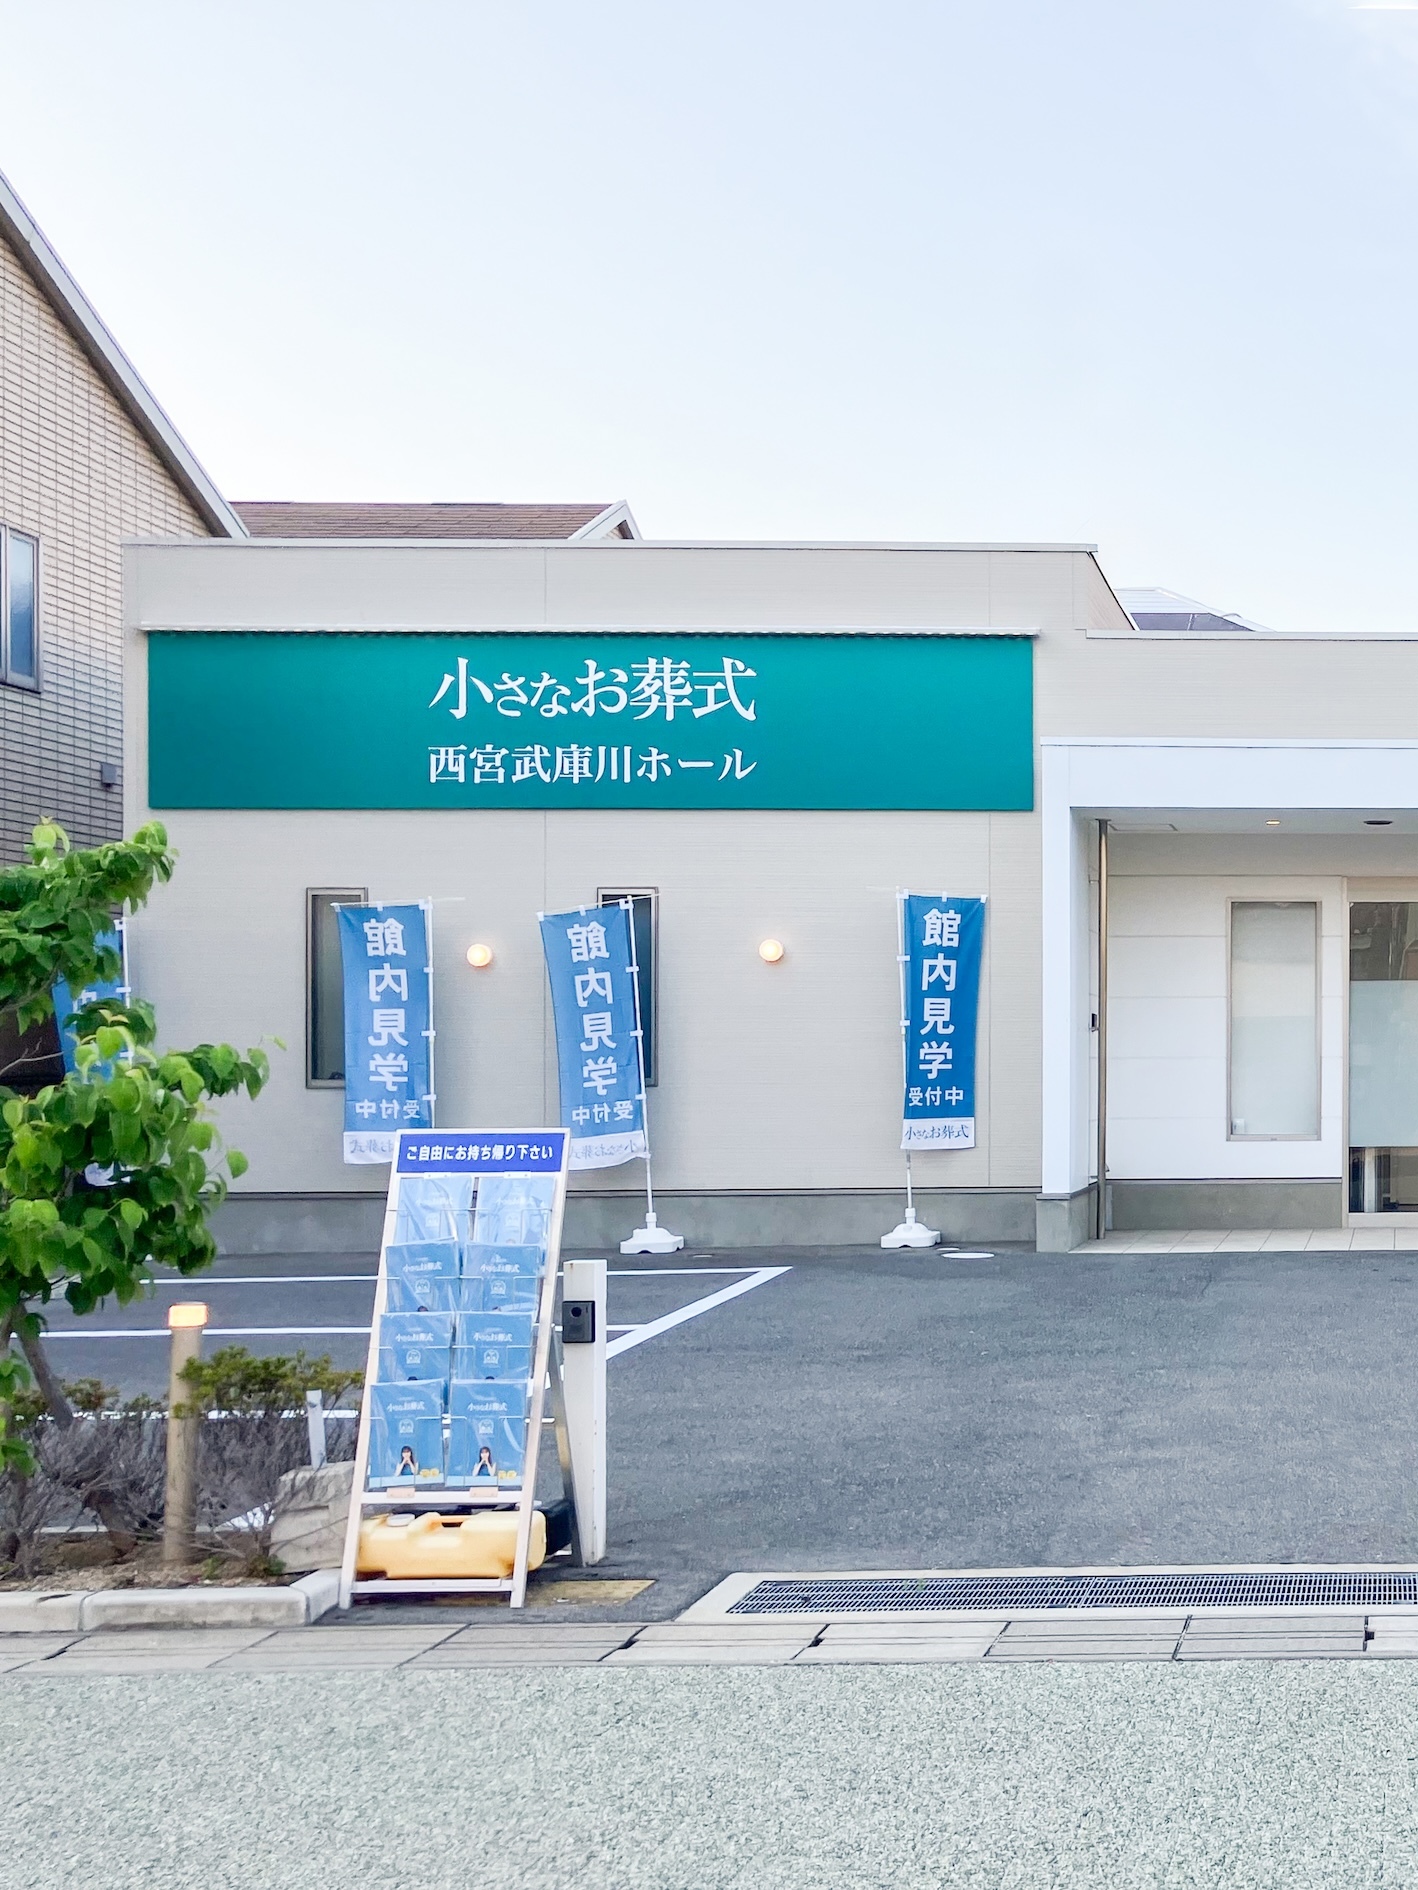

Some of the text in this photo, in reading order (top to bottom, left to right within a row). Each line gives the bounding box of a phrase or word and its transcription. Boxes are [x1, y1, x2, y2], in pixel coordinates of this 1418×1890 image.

[428, 656, 757, 721] 小さなお葬式
[428, 744, 757, 784] 西宮武庫川ホール
[919, 908, 962, 1080] 館内見学
[908, 1086, 964, 1107] 受付中
[406, 1144, 553, 1162] ご自由にお持ち帰り下さい
